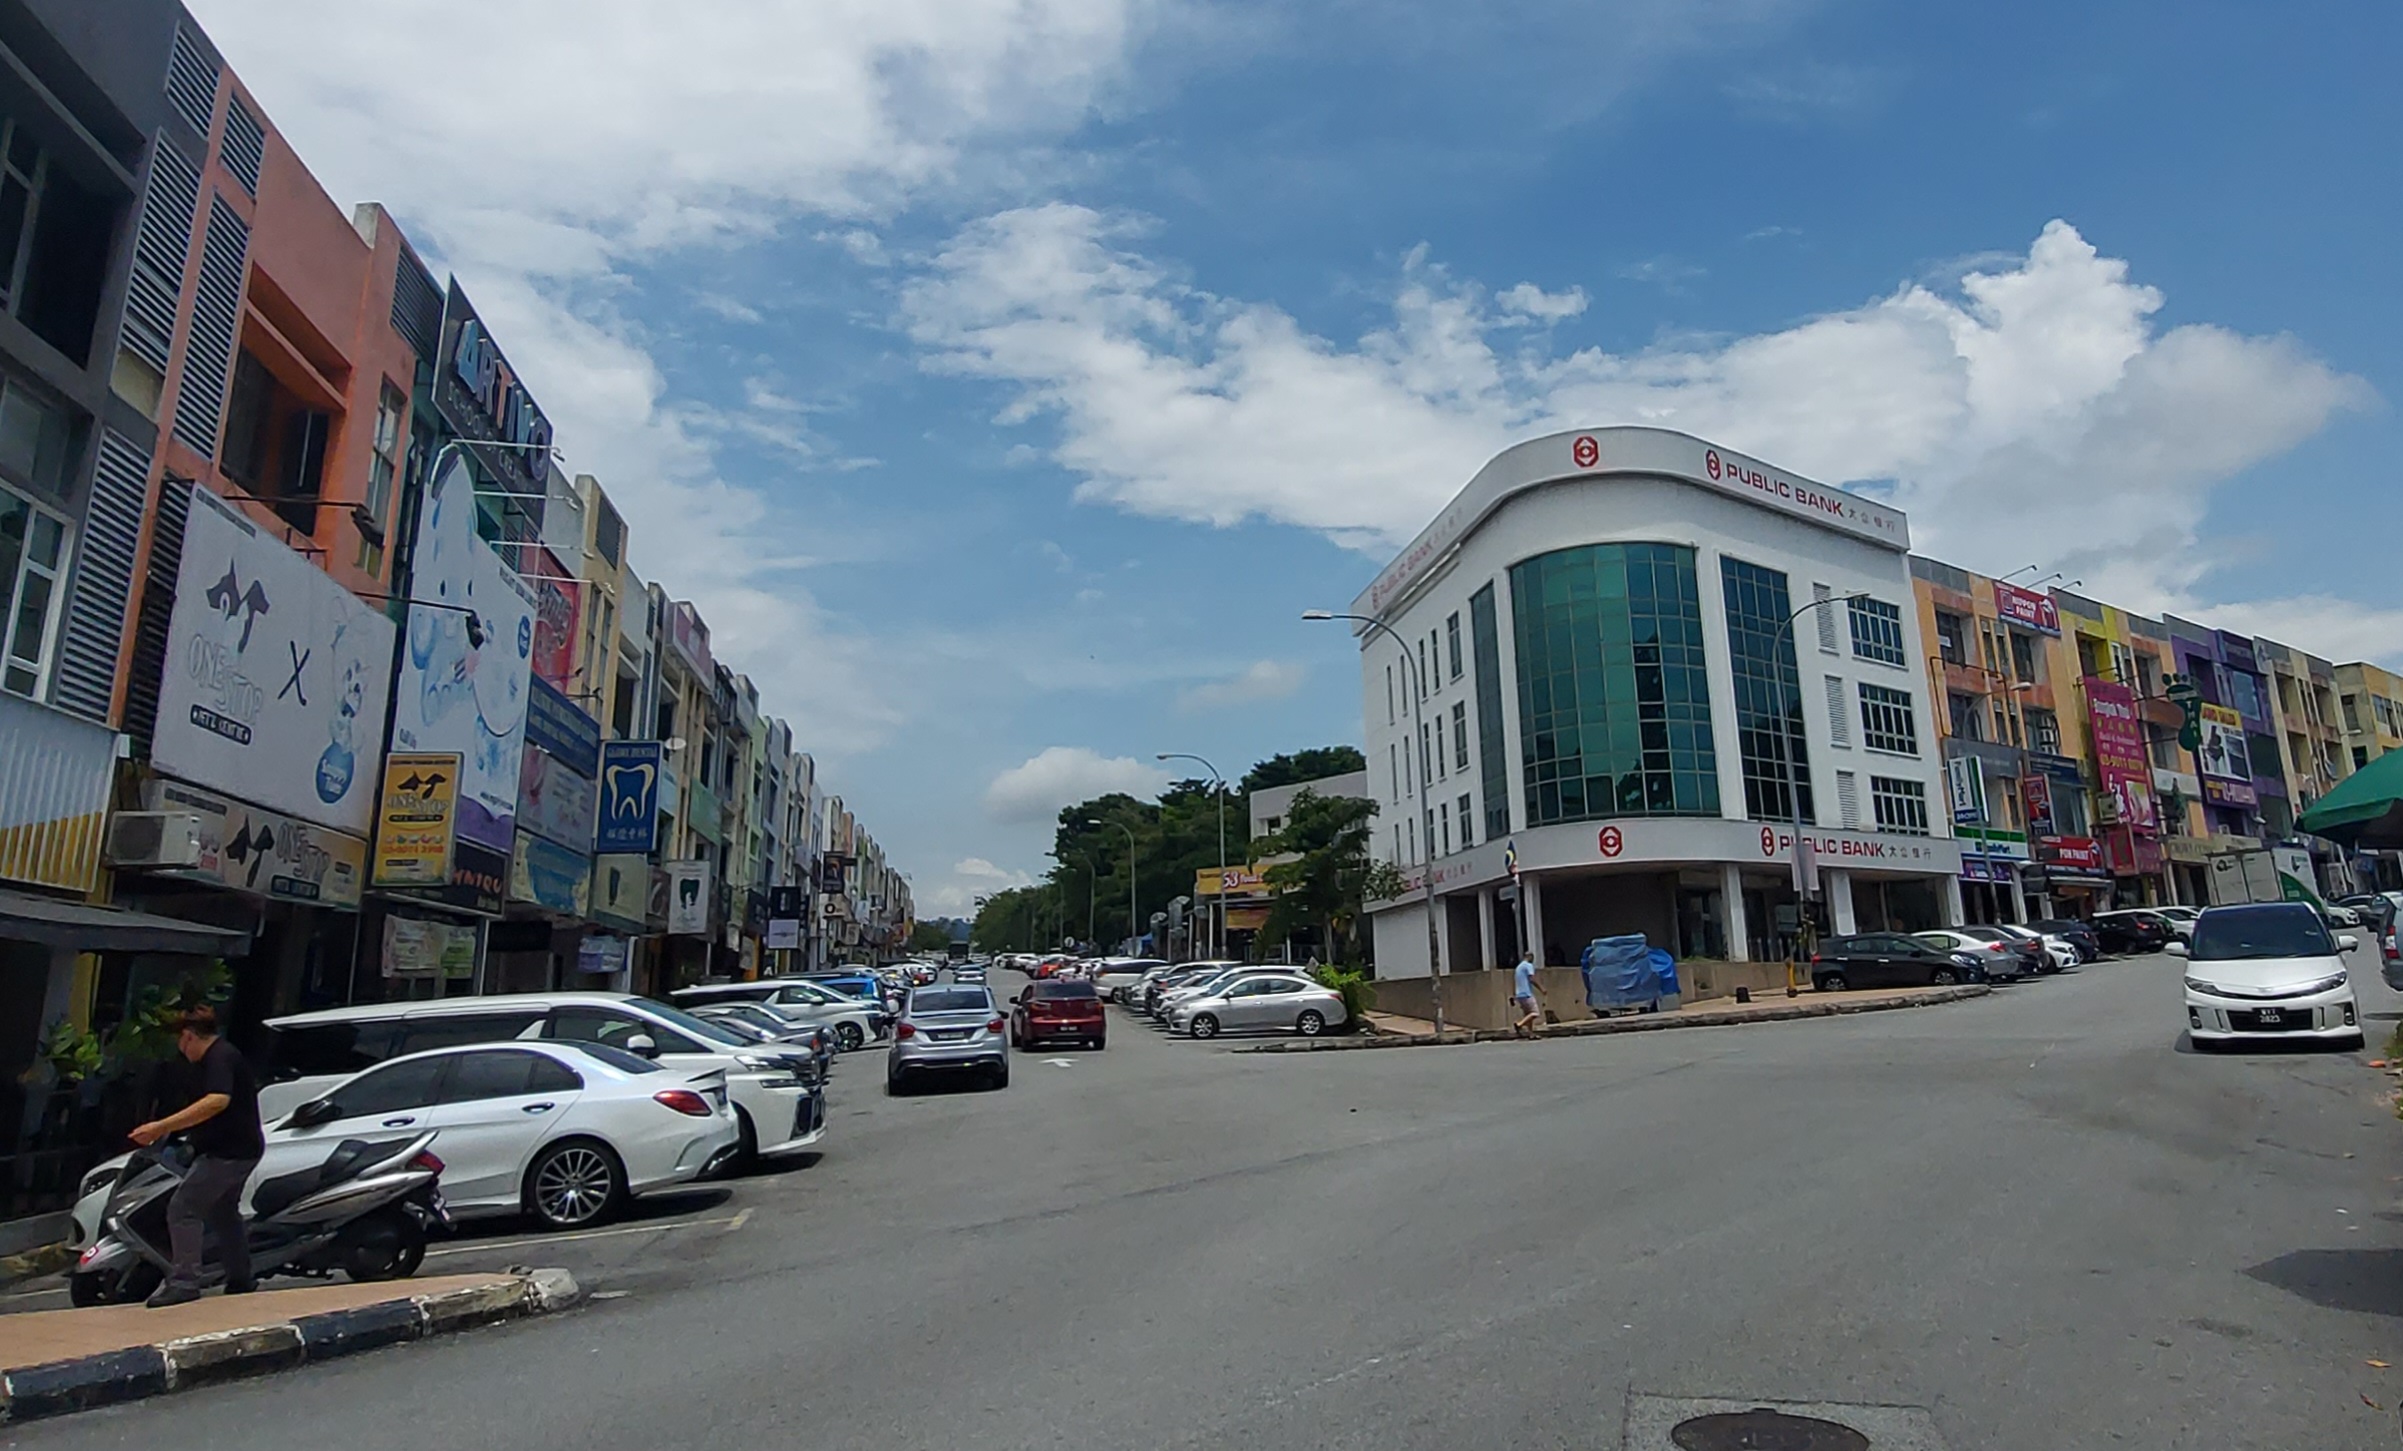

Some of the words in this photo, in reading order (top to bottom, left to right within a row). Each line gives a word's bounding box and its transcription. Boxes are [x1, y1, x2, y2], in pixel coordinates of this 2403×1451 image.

[1725, 462, 1791, 498] PUBLIC
[1795, 487, 1844, 518] BANK
[189, 633, 227, 691] ONE
[1779, 834, 1837, 854] PLIC
[1841, 839, 1885, 858] BANK
